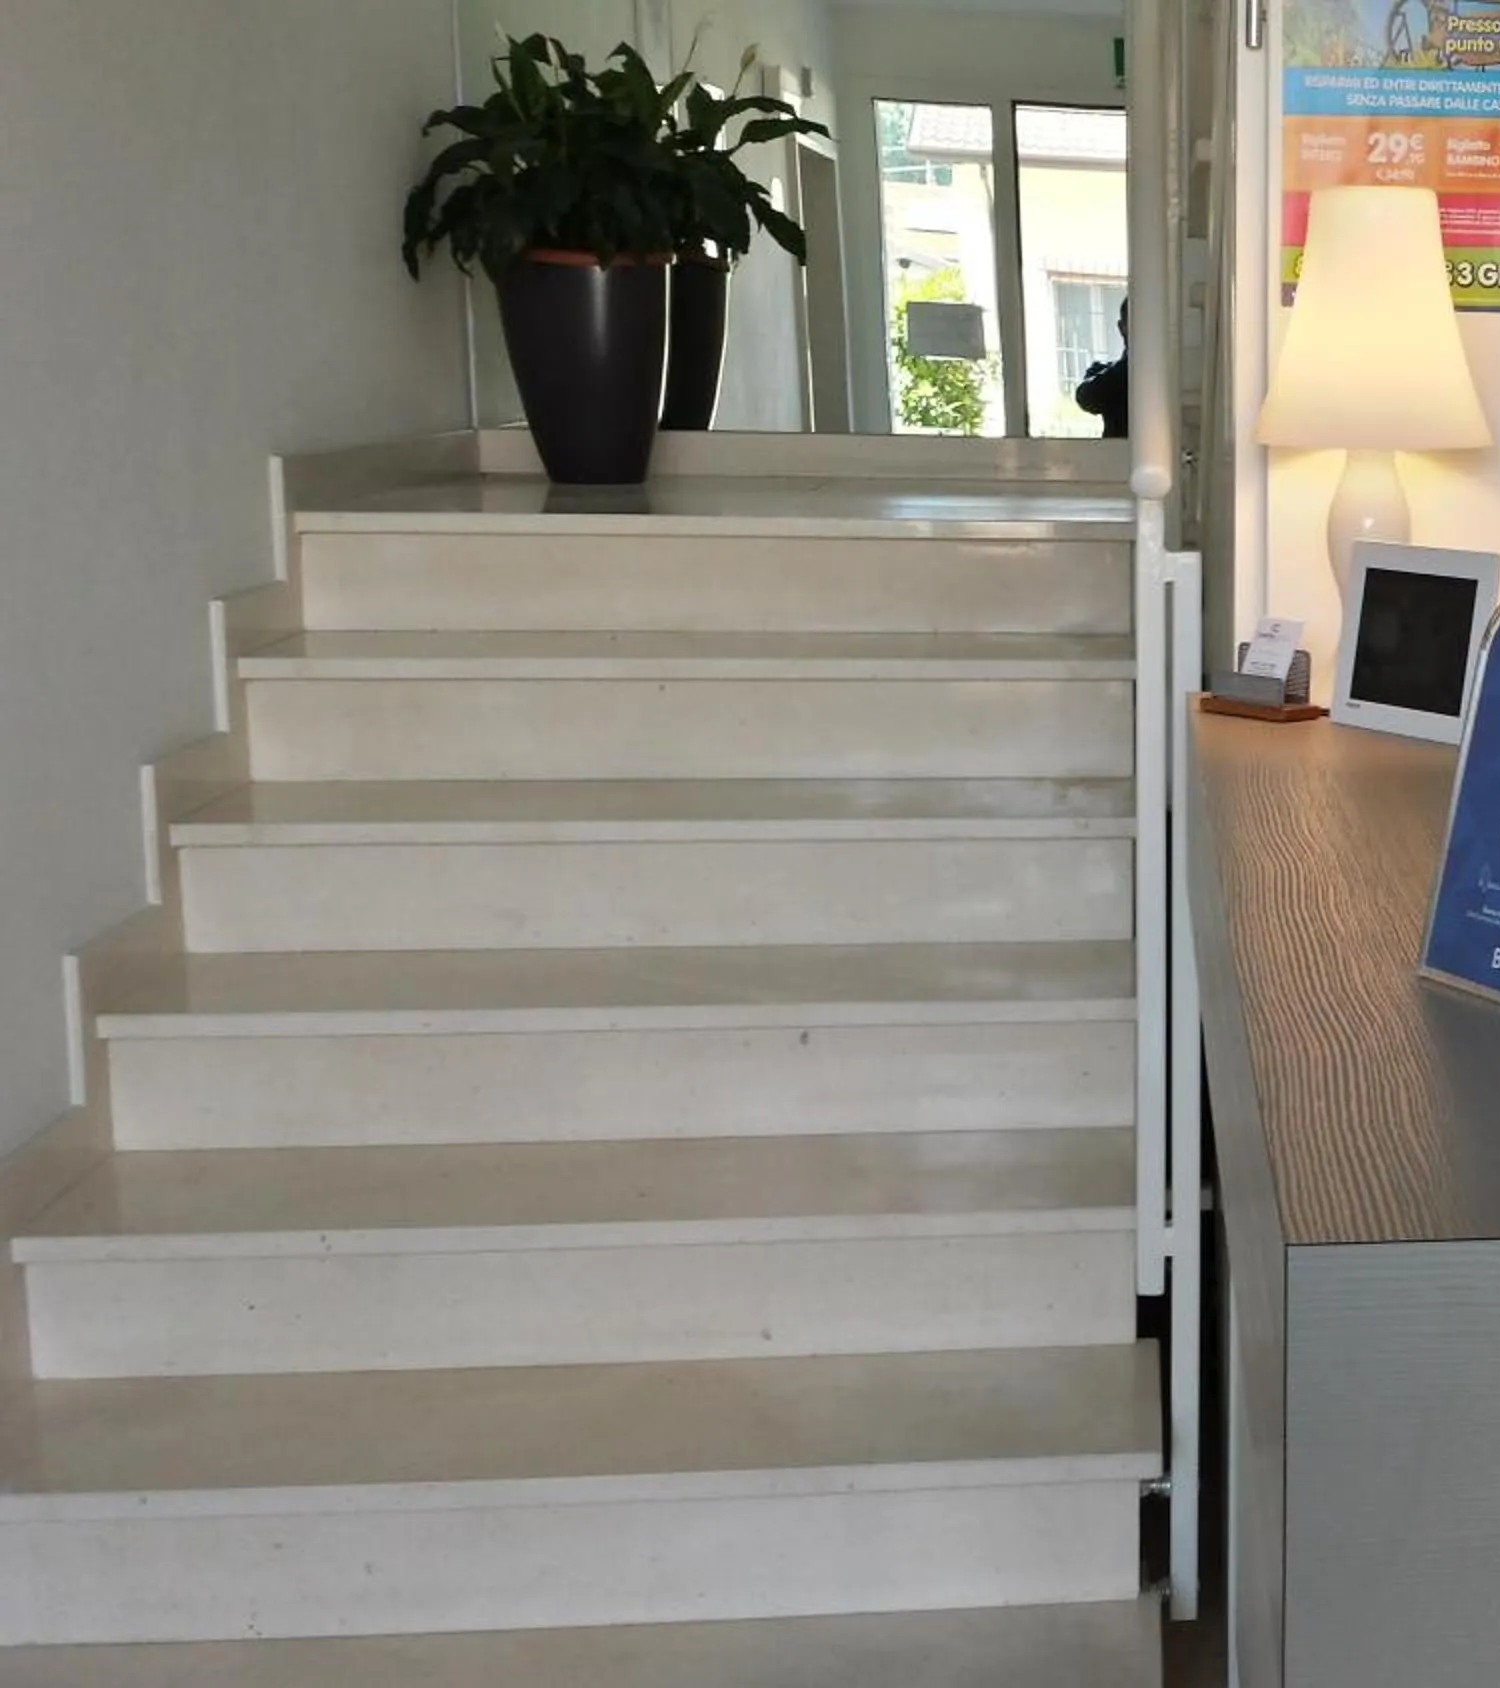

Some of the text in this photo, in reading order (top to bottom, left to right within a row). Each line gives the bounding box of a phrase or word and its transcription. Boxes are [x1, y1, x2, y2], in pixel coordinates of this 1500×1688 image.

[1445, 36, 1495, 54] punto
[1364, 77, 1379, 89] ED
[1383, 78, 1416, 91] ENTRI
[1346, 94, 1387, 106] SENZA
[1389, 95, 1441, 109] PASSARE
[1444, 98, 1479, 110] DALLE
[1457, 261, 1474, 287] 3
